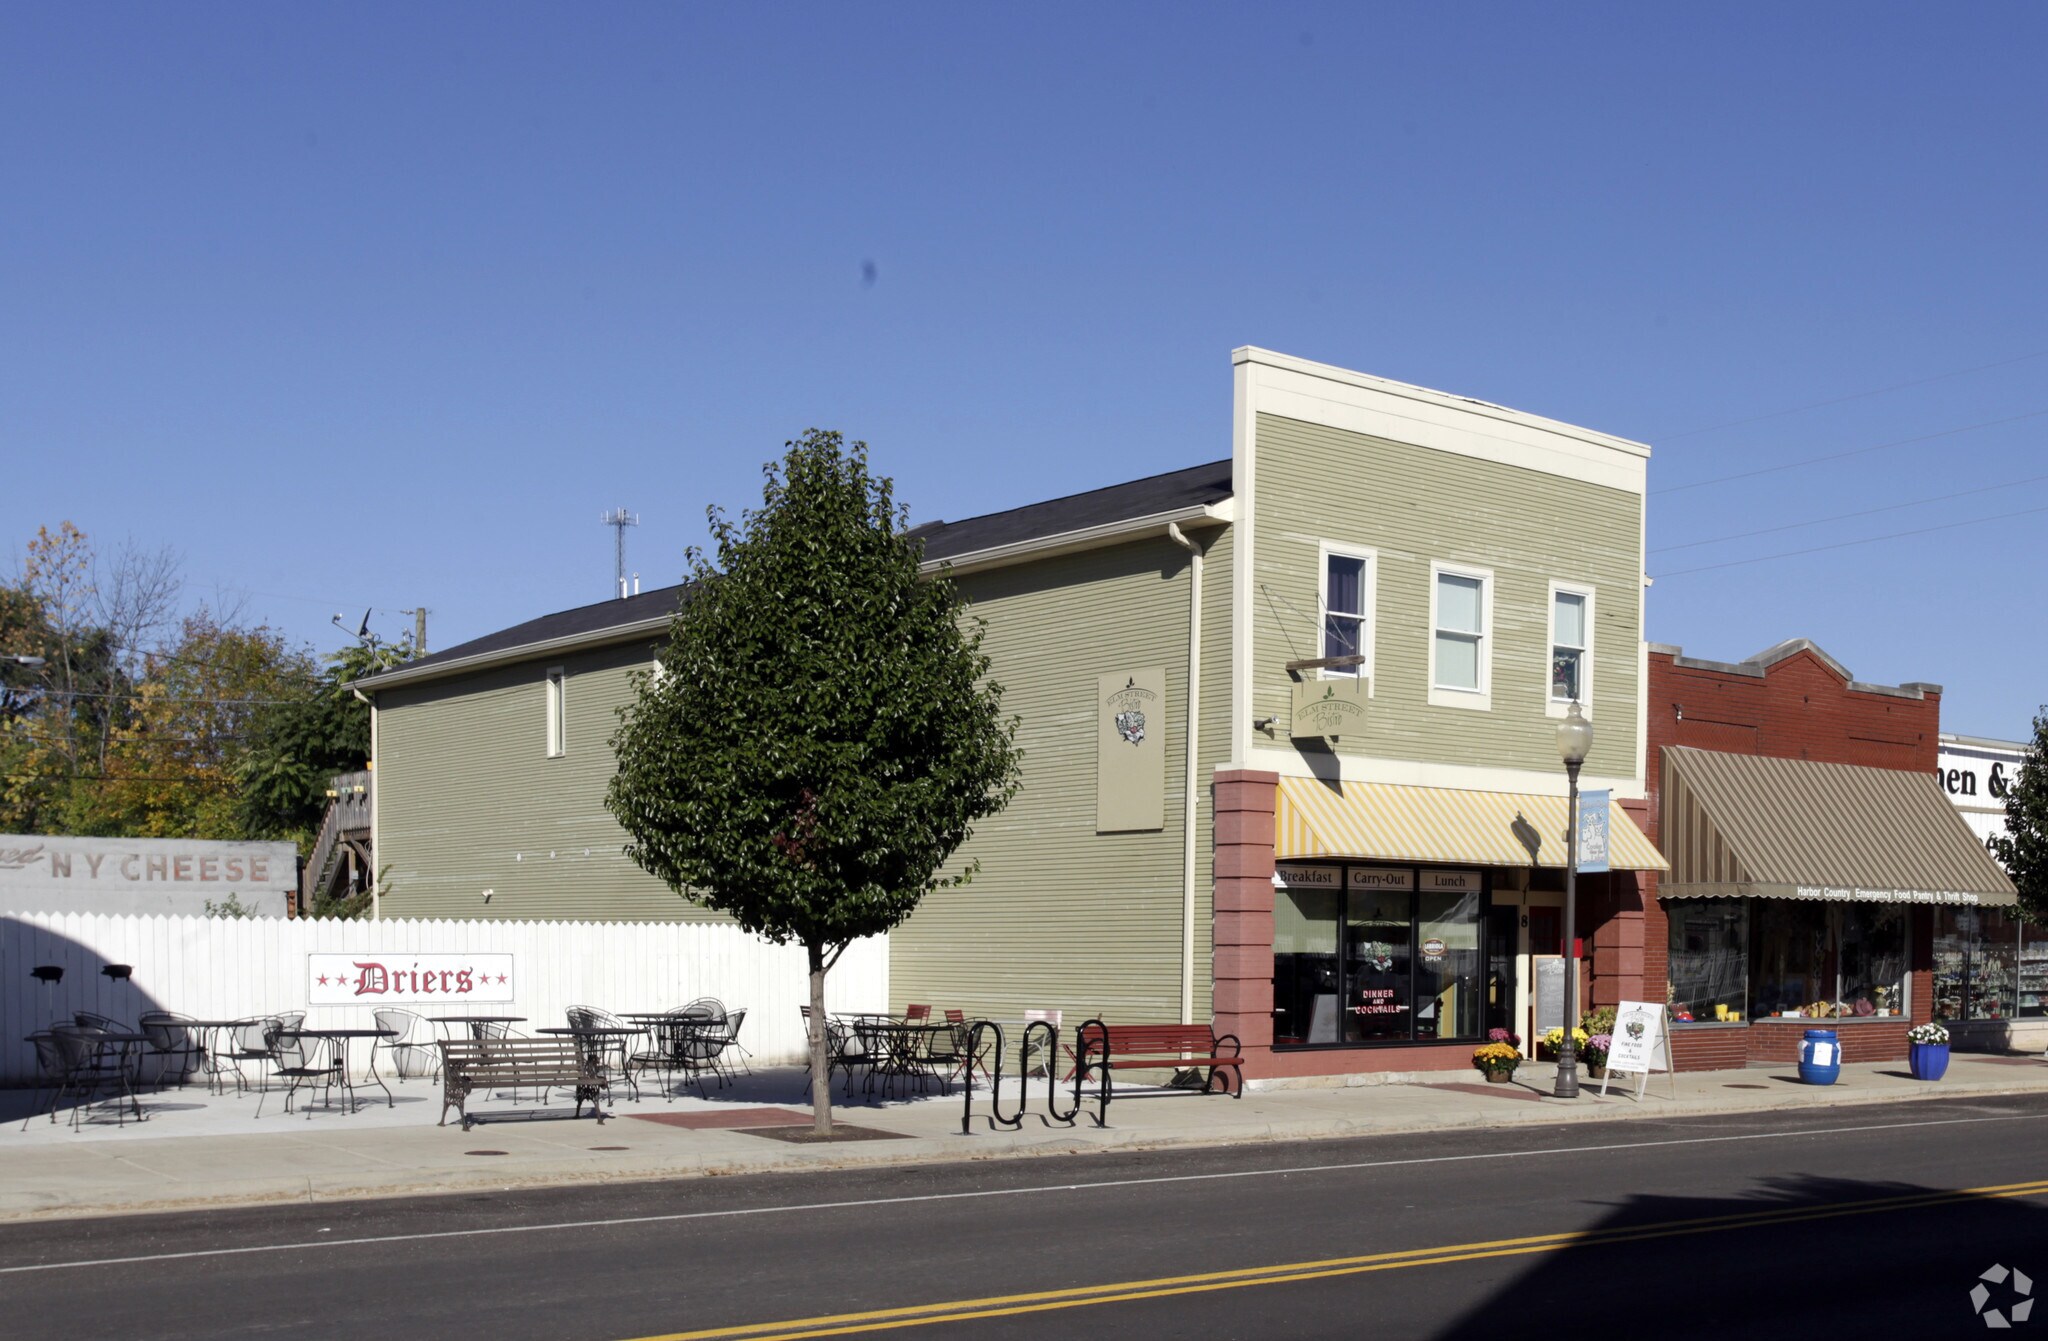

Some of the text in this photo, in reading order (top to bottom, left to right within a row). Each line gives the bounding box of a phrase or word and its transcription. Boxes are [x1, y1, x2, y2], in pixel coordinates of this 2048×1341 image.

[1124, 690, 1157, 702] STREET
[1298, 702, 1364, 721] ELM STREET
[1988, 762, 2012, 799] &
[120, 853, 271, 883] CHEESE
[1279, 869, 1333, 883] Breakfast
[1354, 871, 1406, 888] Carry-Out
[1434, 875, 1466, 887] Lunch
[1797, 886, 1979, 903] Harbor Country Emergency Food Pantry & Thrift Shop
[1520, 916, 1528, 928] 8
[352, 960, 474, 997] Driers
[1362, 989, 1394, 999] DINNER
[1355, 1004, 1401, 1015] COCKTAILS
[1618, 1053, 1641, 1061] COCKTAILS
